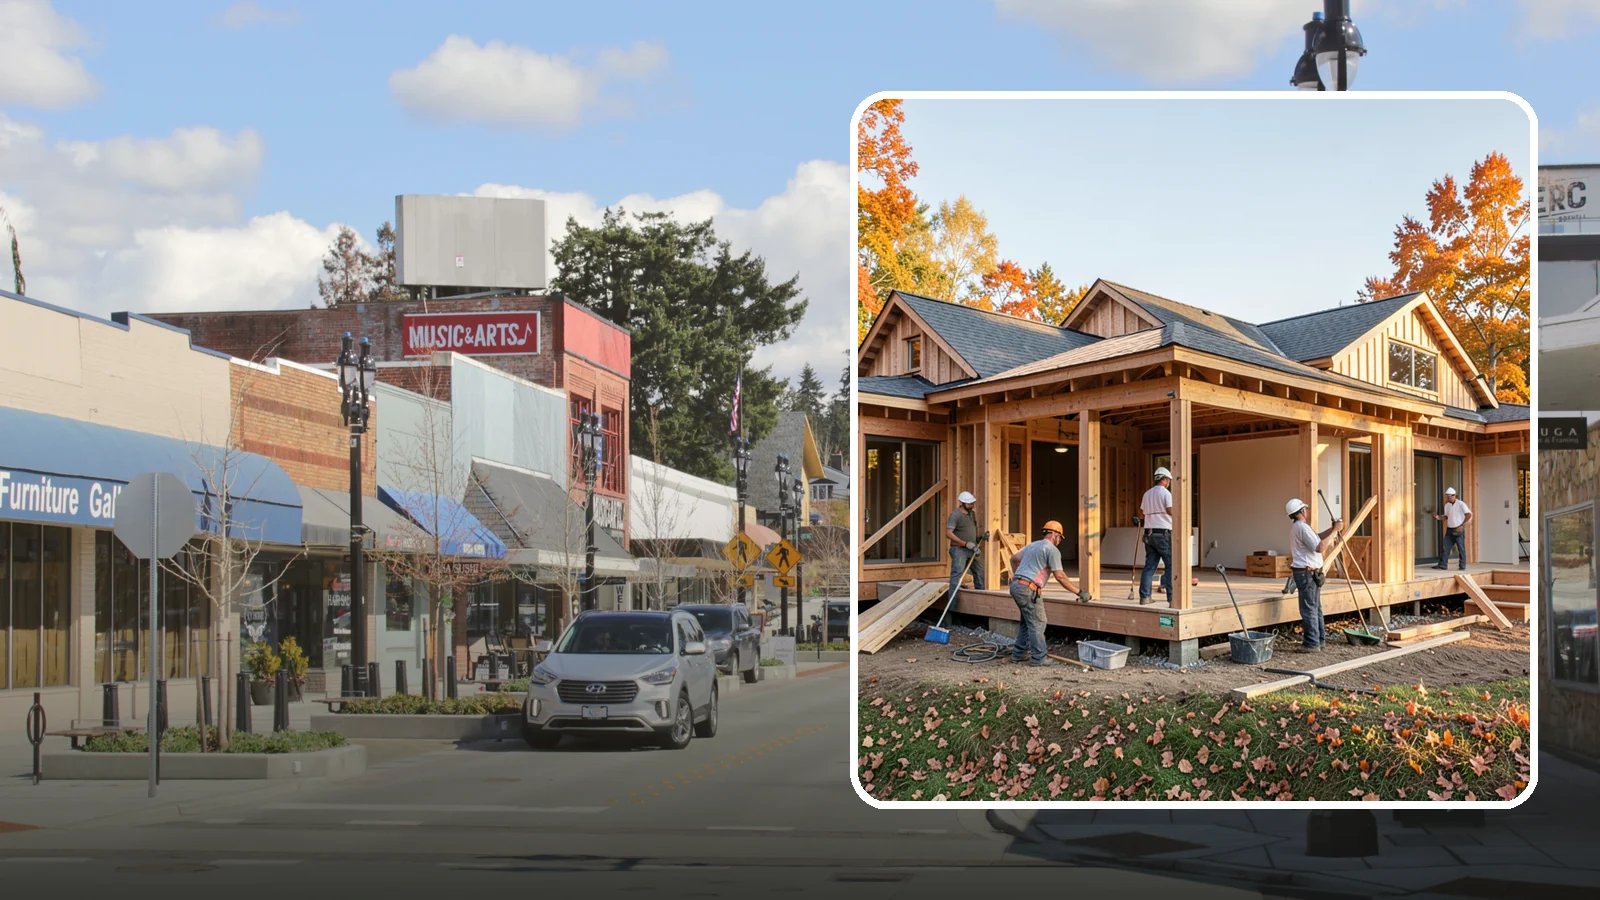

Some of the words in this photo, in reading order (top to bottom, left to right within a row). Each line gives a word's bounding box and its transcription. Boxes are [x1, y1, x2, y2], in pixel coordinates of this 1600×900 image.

[409, 323, 519, 349] MUSIC&ARTS
[1540, 427, 1577, 437] UGA
[0, 472, 79, 515] Furniture
[453, 563, 479, 574] SUSHI
